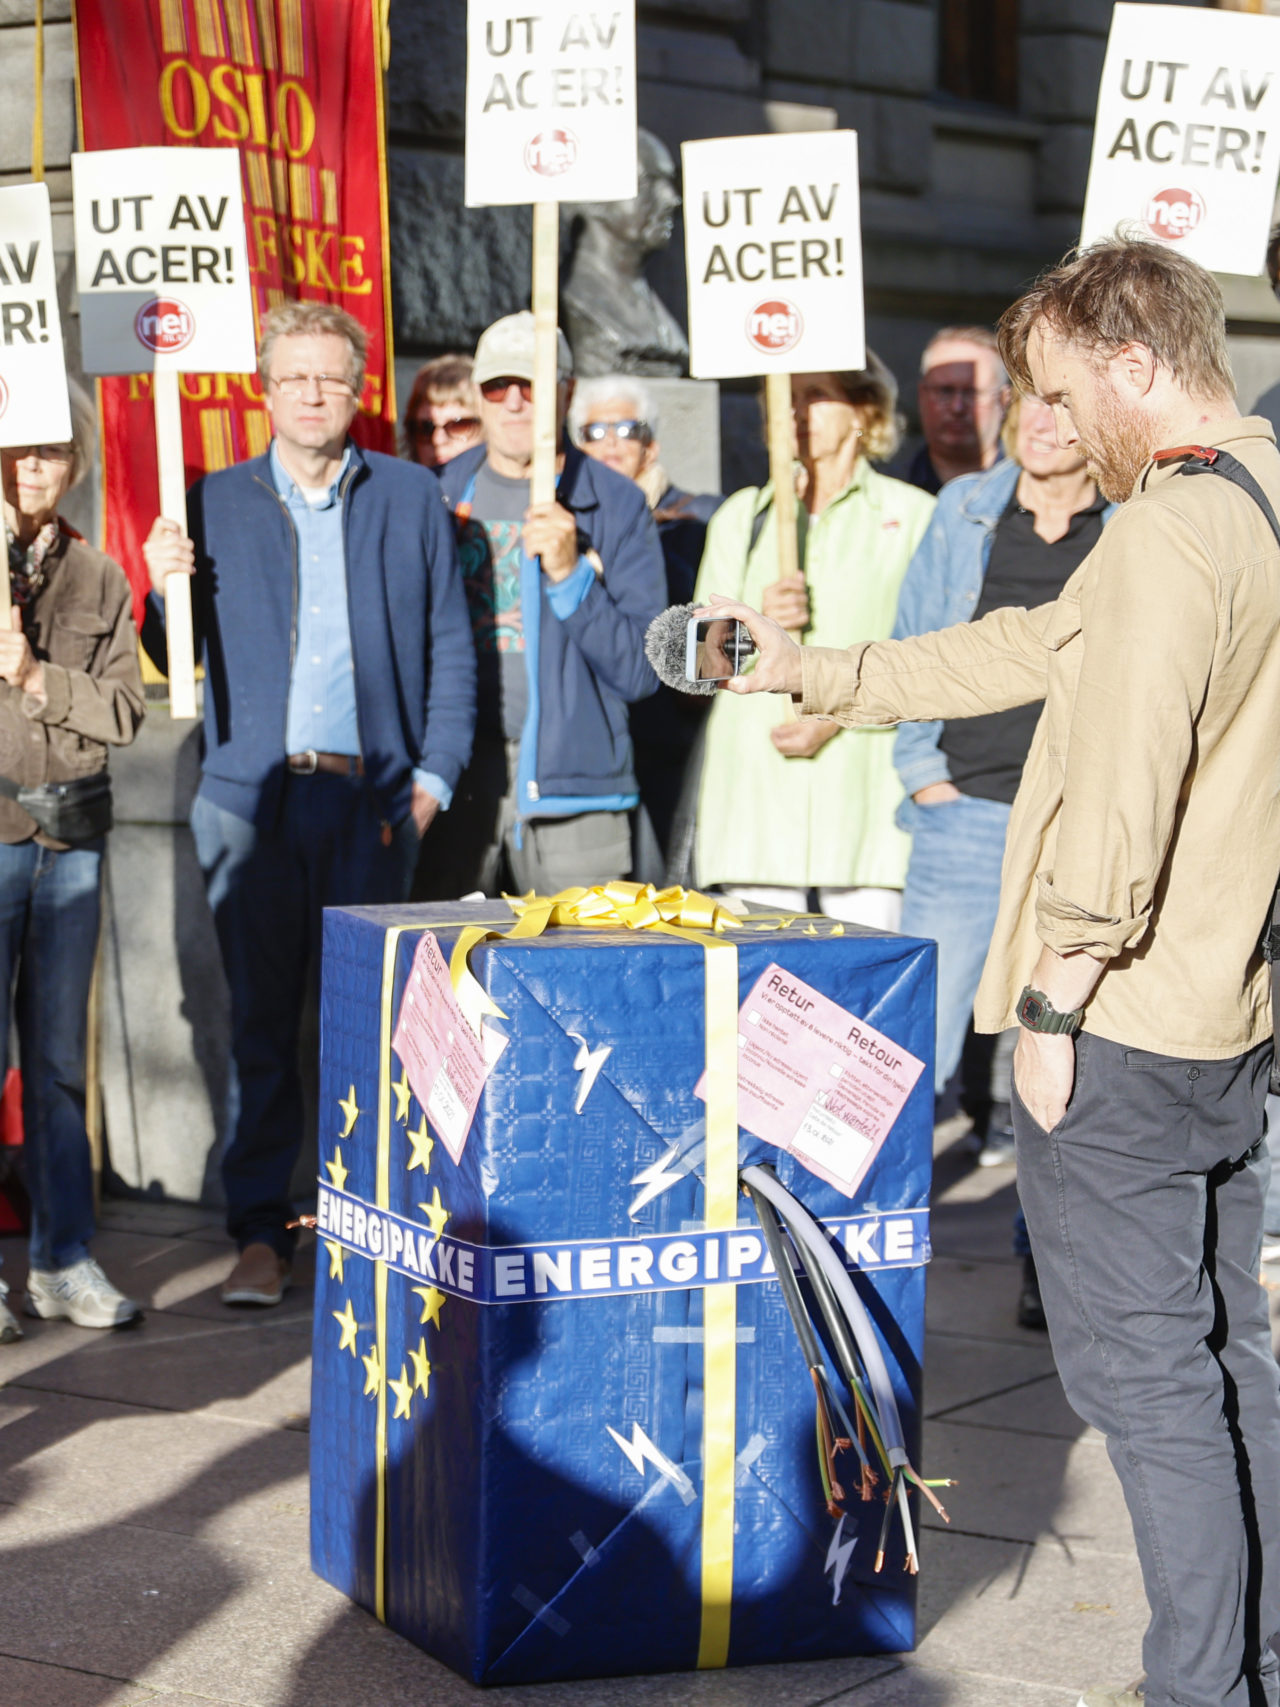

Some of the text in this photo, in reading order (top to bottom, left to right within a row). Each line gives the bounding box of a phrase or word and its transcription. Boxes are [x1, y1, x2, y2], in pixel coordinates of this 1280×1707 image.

[485, 12, 622, 57] UT AV
[482, 67, 625, 113] ACER!
[1120, 59, 1275, 112] UT AV
[160, 59, 316, 159] OSLO
[1107, 118, 1267, 174] ACER!
[91, 195, 230, 235] UT AV
[702, 183, 839, 228] UT AV
[1148, 192, 1201, 228] nei
[91, 245, 235, 288] ACER!
[702, 238, 846, 284] ACER!
[143, 305, 188, 336] nei
[751, 304, 797, 337] nei
[768, 974, 902, 1071] Retur Retour
[318, 1187, 475, 1293] ENERGIPAKKE
[494, 1218, 916, 1297] ENERGIPAKE
